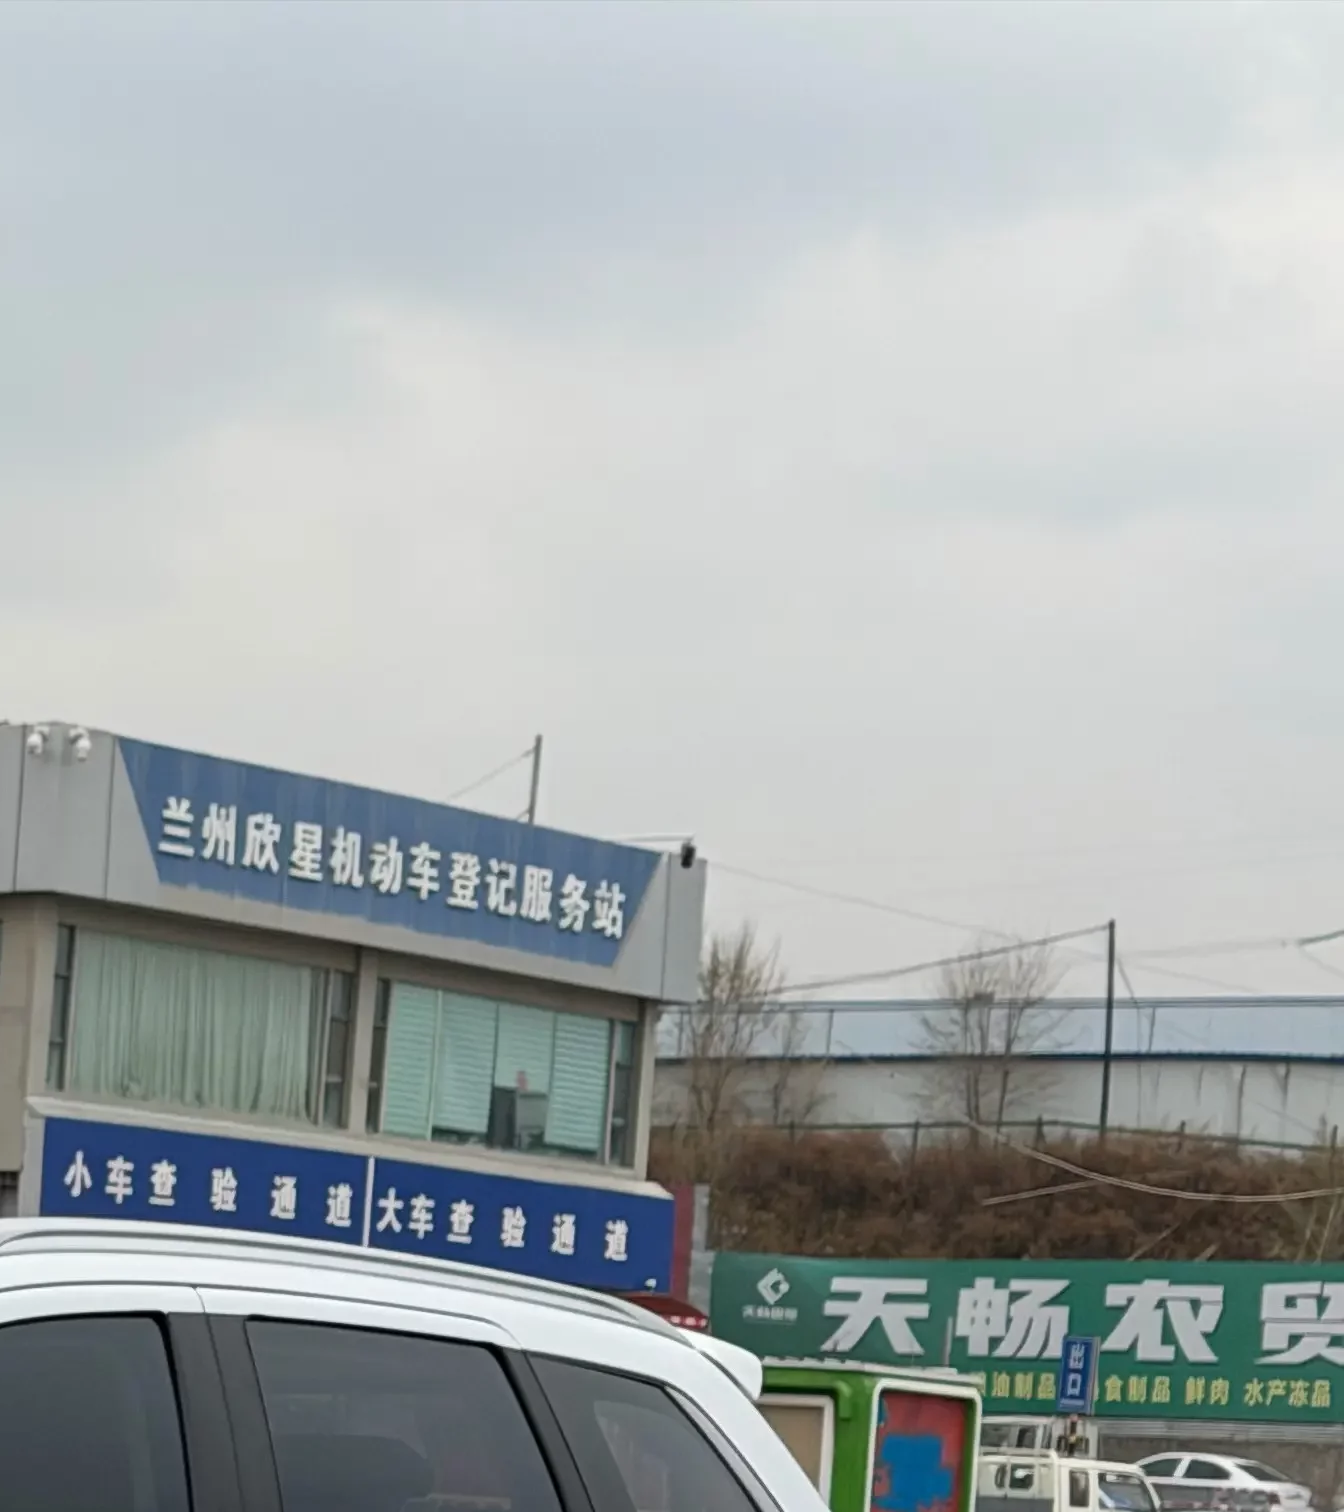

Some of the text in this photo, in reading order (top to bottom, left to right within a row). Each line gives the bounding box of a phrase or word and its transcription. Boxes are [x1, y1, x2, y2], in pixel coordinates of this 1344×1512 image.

[158, 796, 626, 939] 兰州欣星机动车登记服务站
[64, 1150, 353, 1227] 小车查验通道
[376, 1187, 629, 1261] 大车查验通道
[819, 1276, 1344, 1365] 天畅农贸
[974, 1371, 1057, 1400] 油制品
[1096, 1374, 1171, 1403] 食制品
[1243, 1377, 1331, 1408] 水产冻品
[1066, 1343, 1085, 1397] 出口
